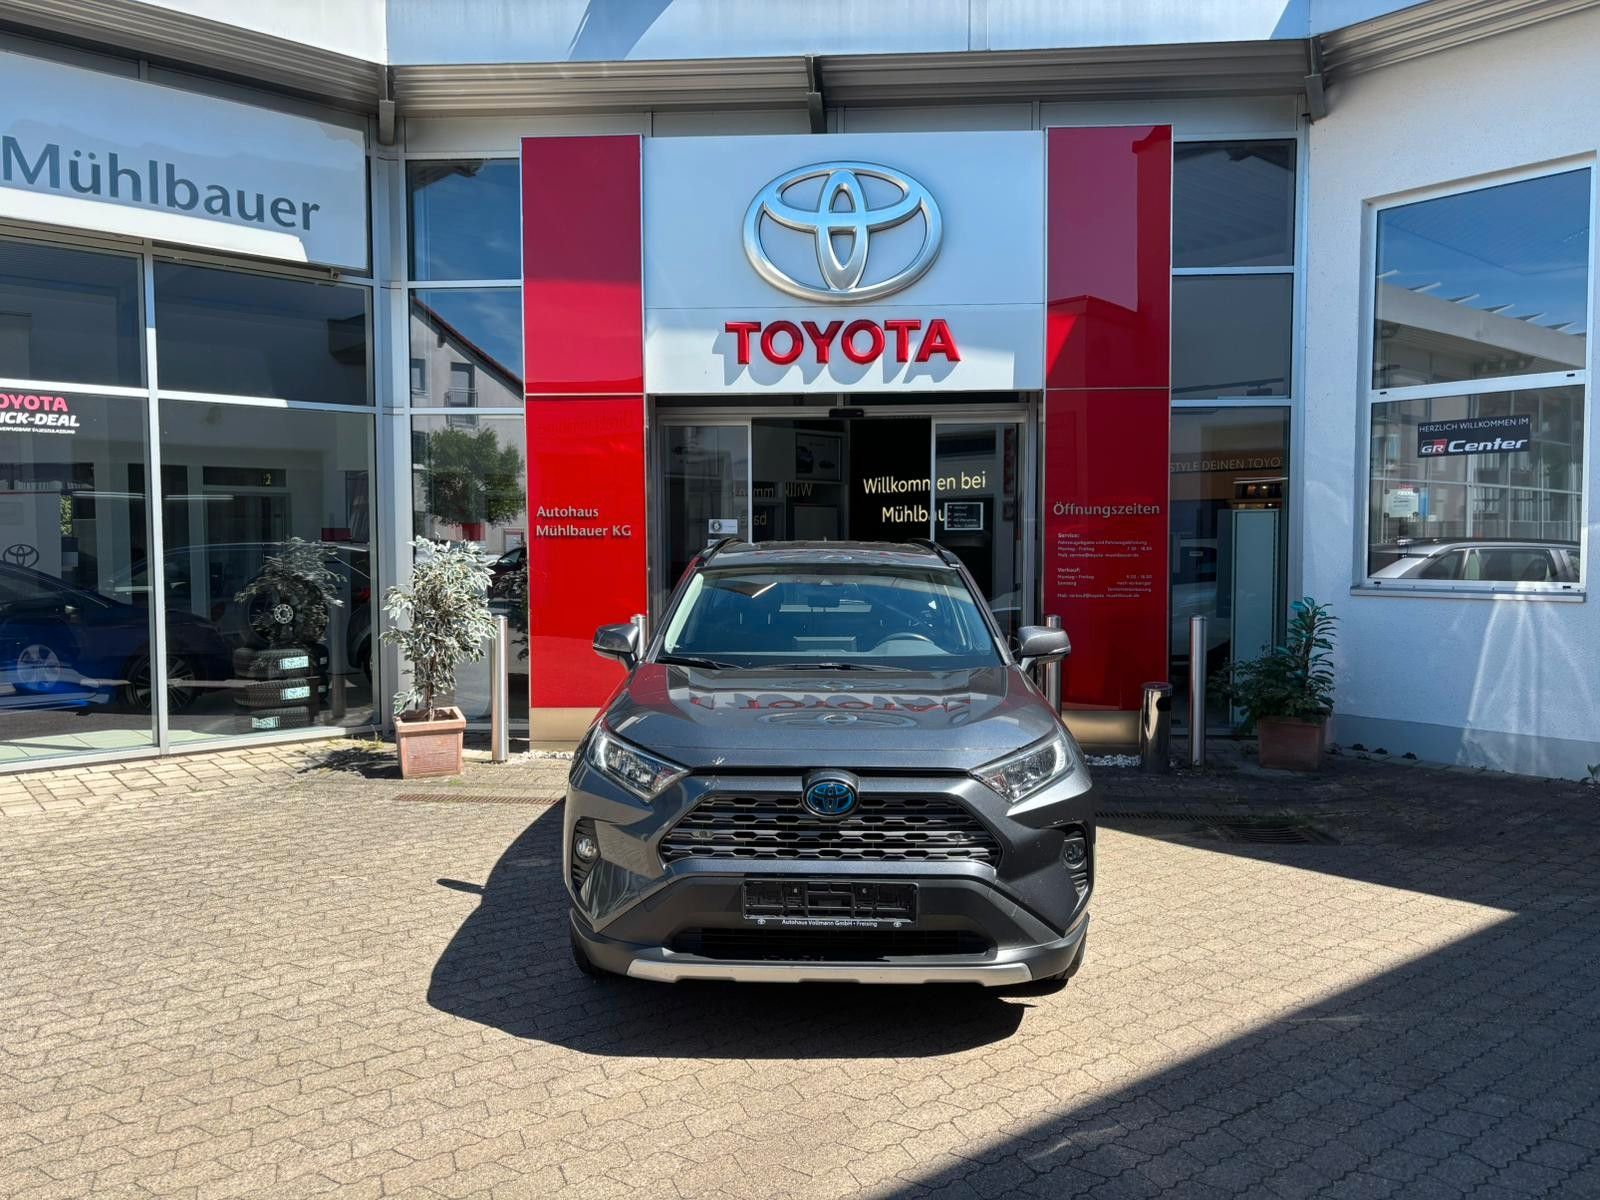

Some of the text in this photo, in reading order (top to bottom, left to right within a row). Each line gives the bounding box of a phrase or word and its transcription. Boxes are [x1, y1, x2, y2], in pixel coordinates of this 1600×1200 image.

[1, 135, 321, 231] Mühlbauer
[724, 319, 961, 366] TOYOTA
[1420, 417, 1529, 432] HERZLICH WILLKOMMEN IM
[1421, 438, 1528, 454] GR Center
[1170, 456, 1283, 473] STYLE DEINEN TOYO
[961, 470, 986, 489] bei
[536, 505, 599, 517] Autohaus
[1053, 501, 1160, 518] Öffnungszeiten
[536, 524, 632, 537] Mühlbauer KG
